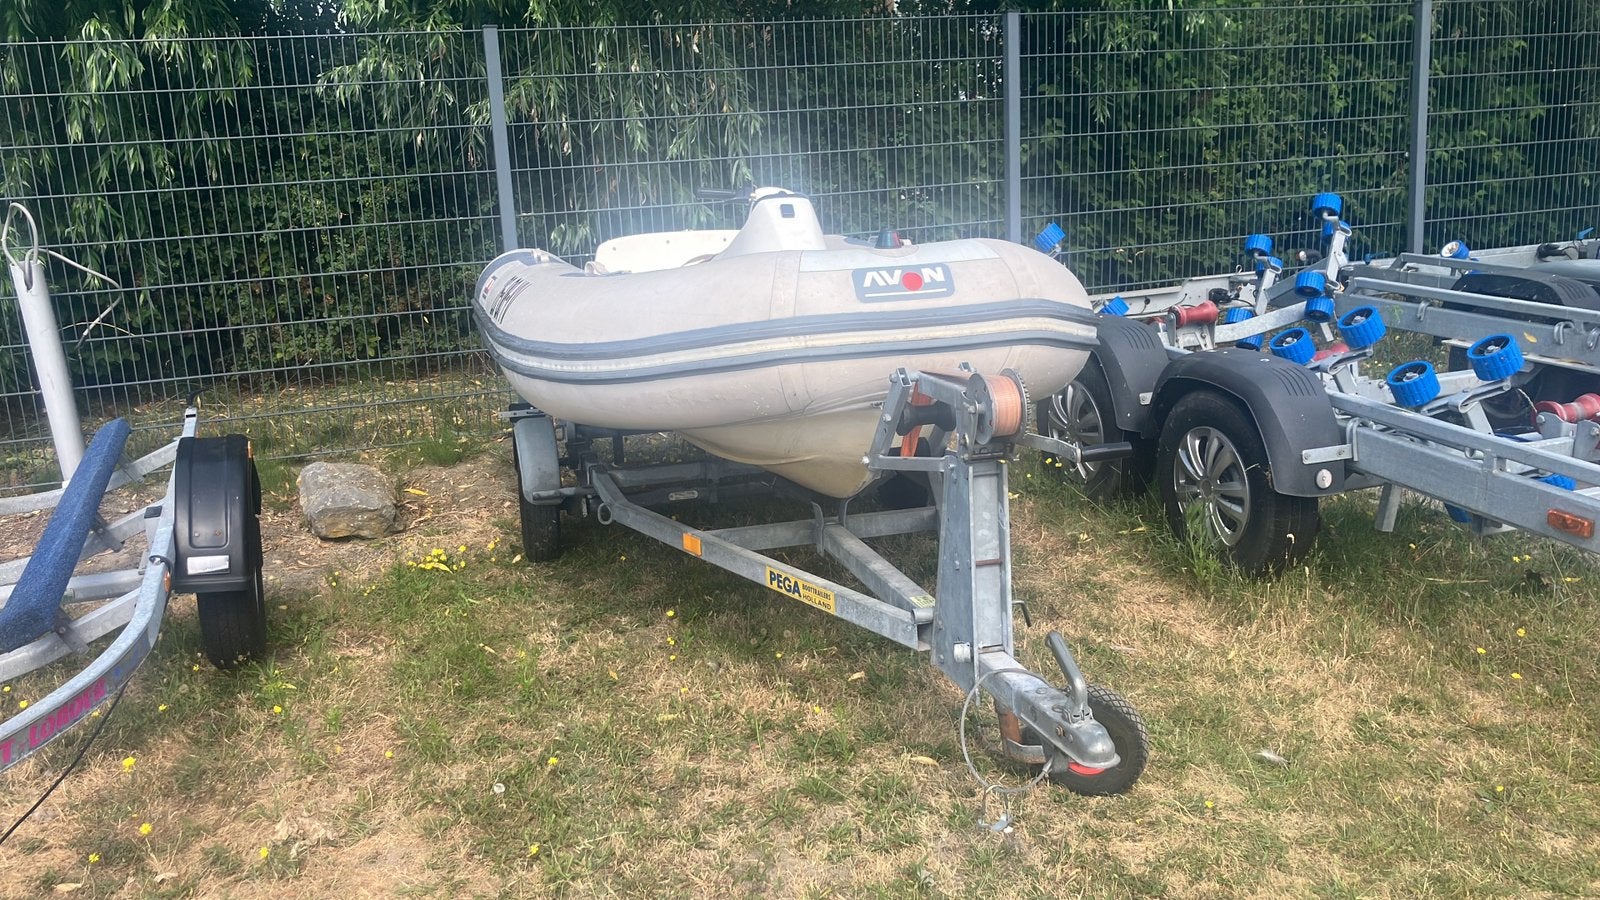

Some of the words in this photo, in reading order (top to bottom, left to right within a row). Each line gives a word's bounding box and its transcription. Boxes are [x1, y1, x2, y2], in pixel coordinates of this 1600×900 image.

[863, 266, 946, 292] AVON
[769, 570, 802, 598] PEGA
[802, 583, 831, 601] BOOTTRAILERS
[802, 593, 832, 610] HOLLAND
